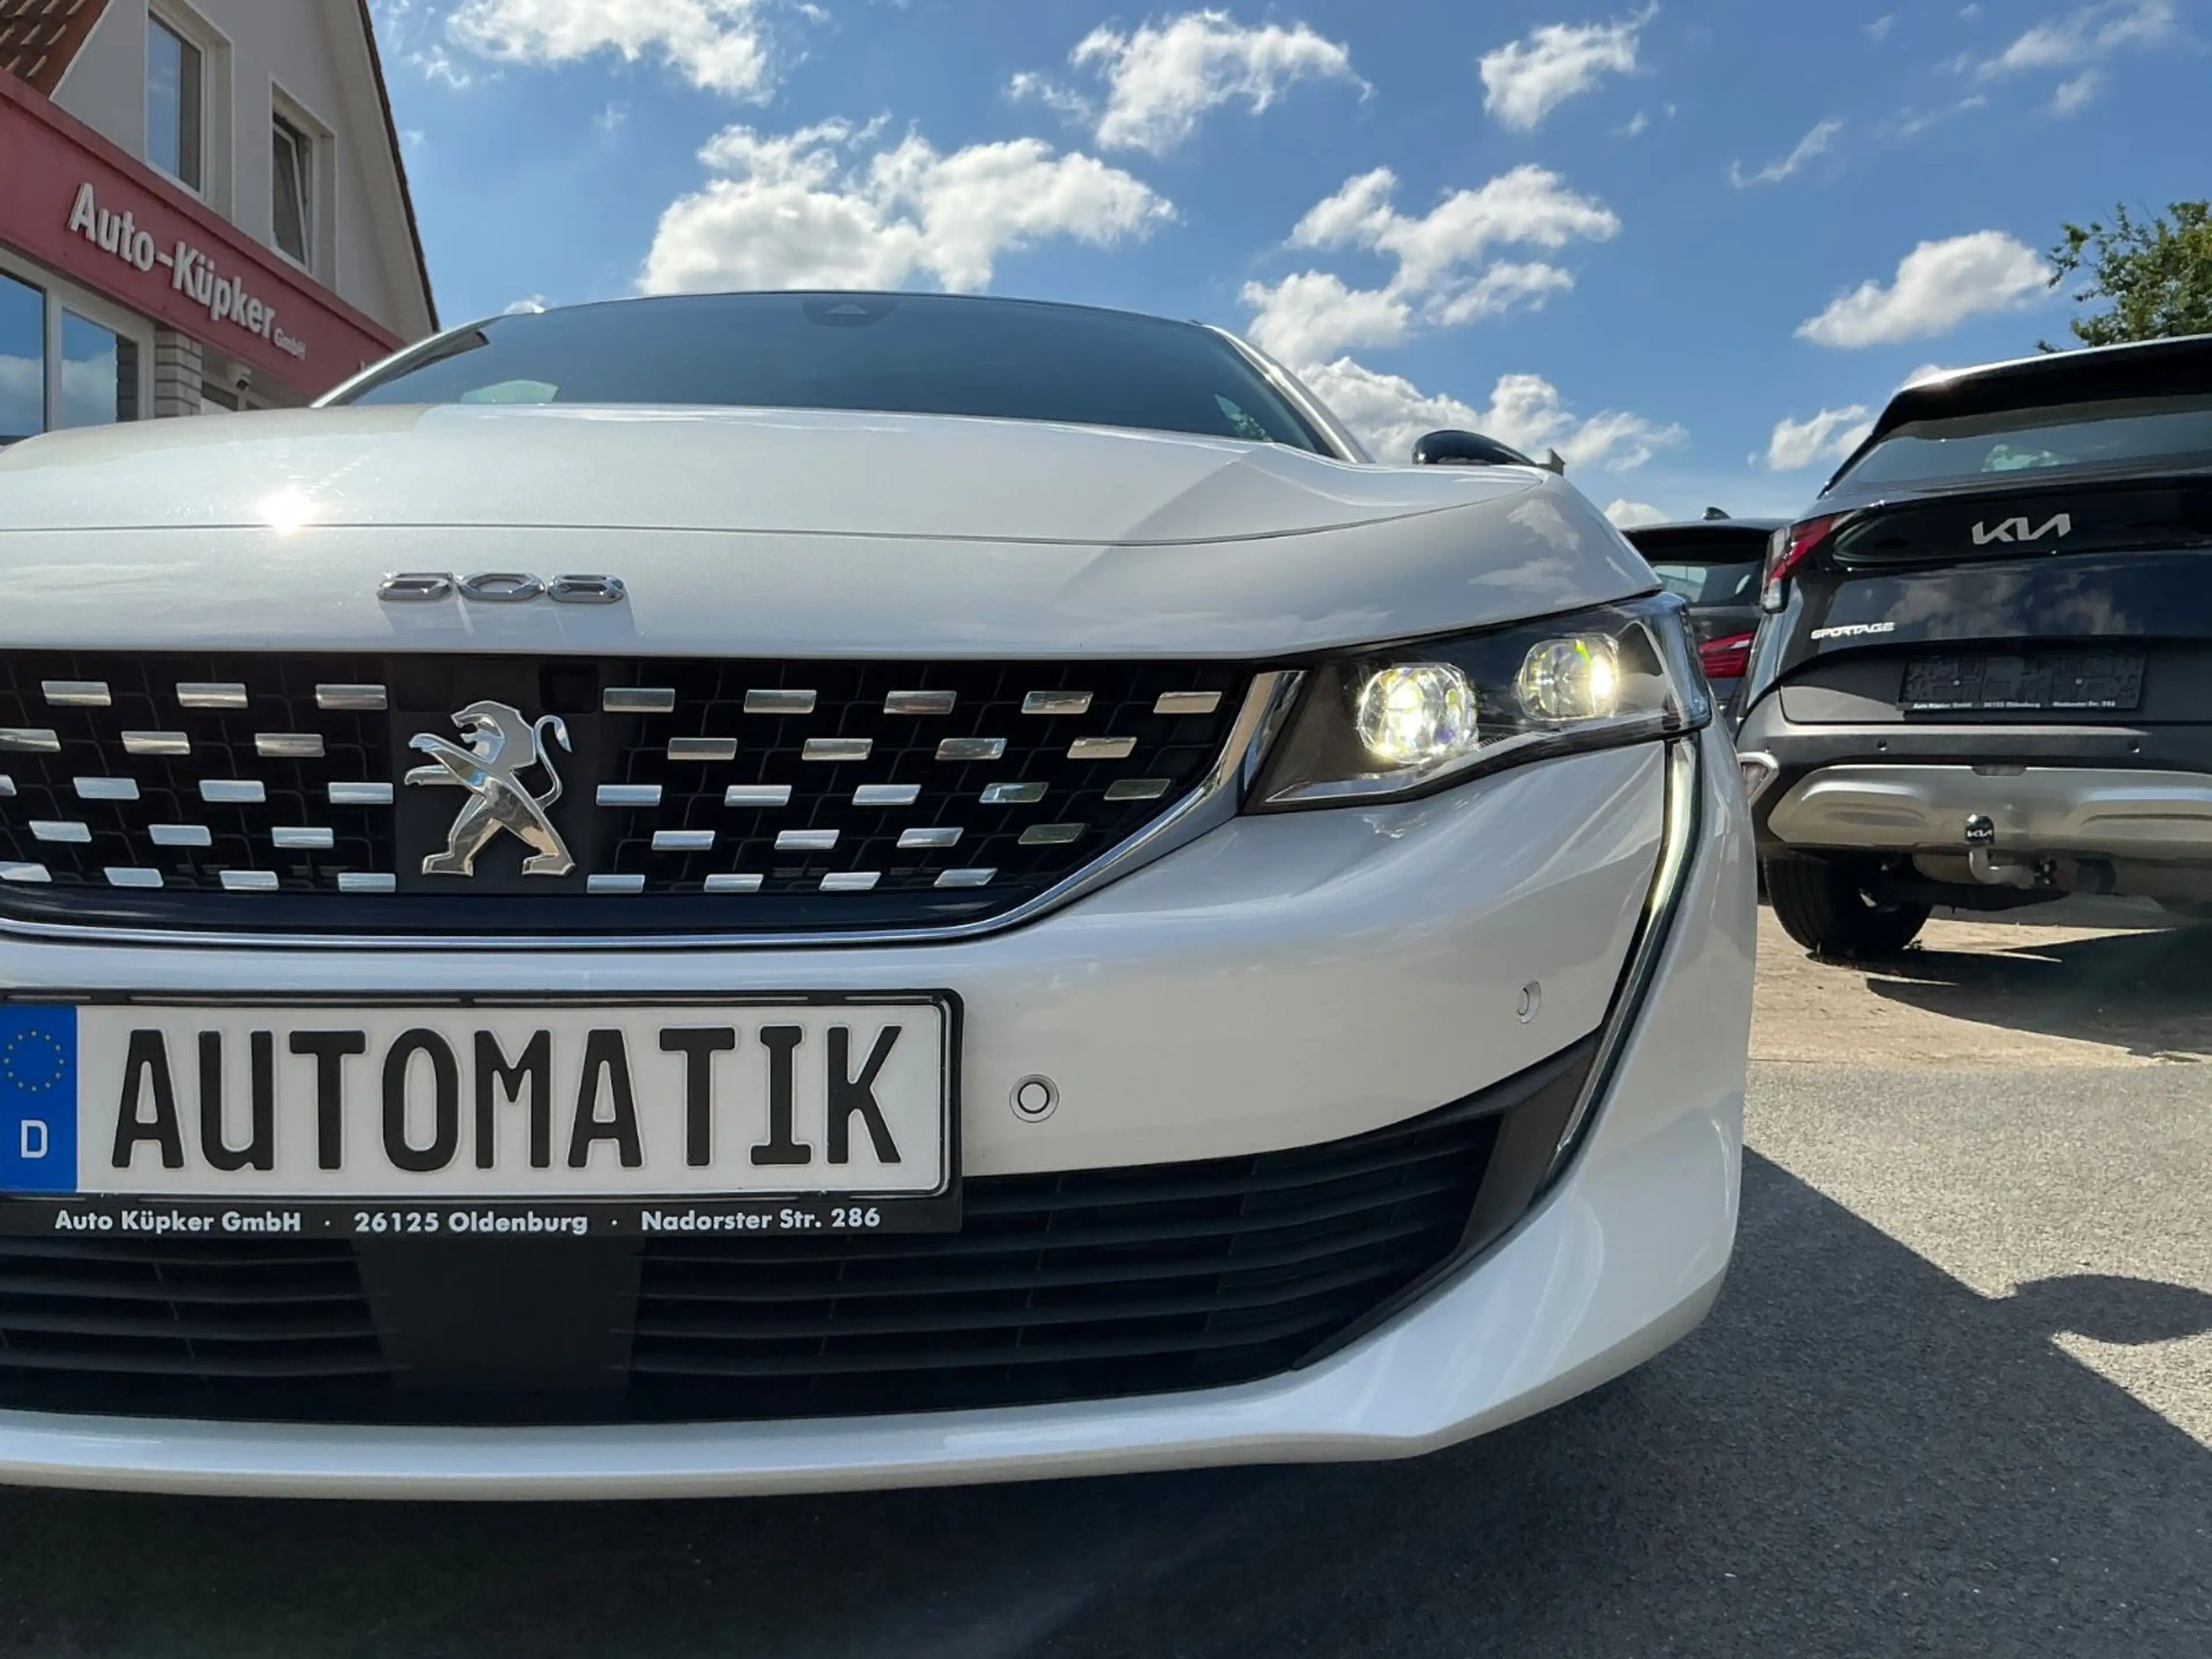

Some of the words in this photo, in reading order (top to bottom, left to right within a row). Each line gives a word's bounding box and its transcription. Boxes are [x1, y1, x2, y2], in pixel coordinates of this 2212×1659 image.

[67, 181, 276, 339] Auto-Küpker
[1971, 513, 2071, 546] KIA
[1810, 622, 1896, 639] SPORTAGE
[111, 1025, 903, 1172] AUTOMATIK
[20, 1119, 48, 1158] D
[55, 1210, 113, 1230] Auto
[122, 1210, 214, 1235] Küpker
[222, 1211, 301, 1232] GmbH
[354, 1211, 439, 1233] 26125
[449, 1210, 588, 1236] Oldenburg
[642, 1209, 772, 1231] Nadorster
[780, 1208, 822, 1229] Str.
[831, 1207, 880, 1228] 286
